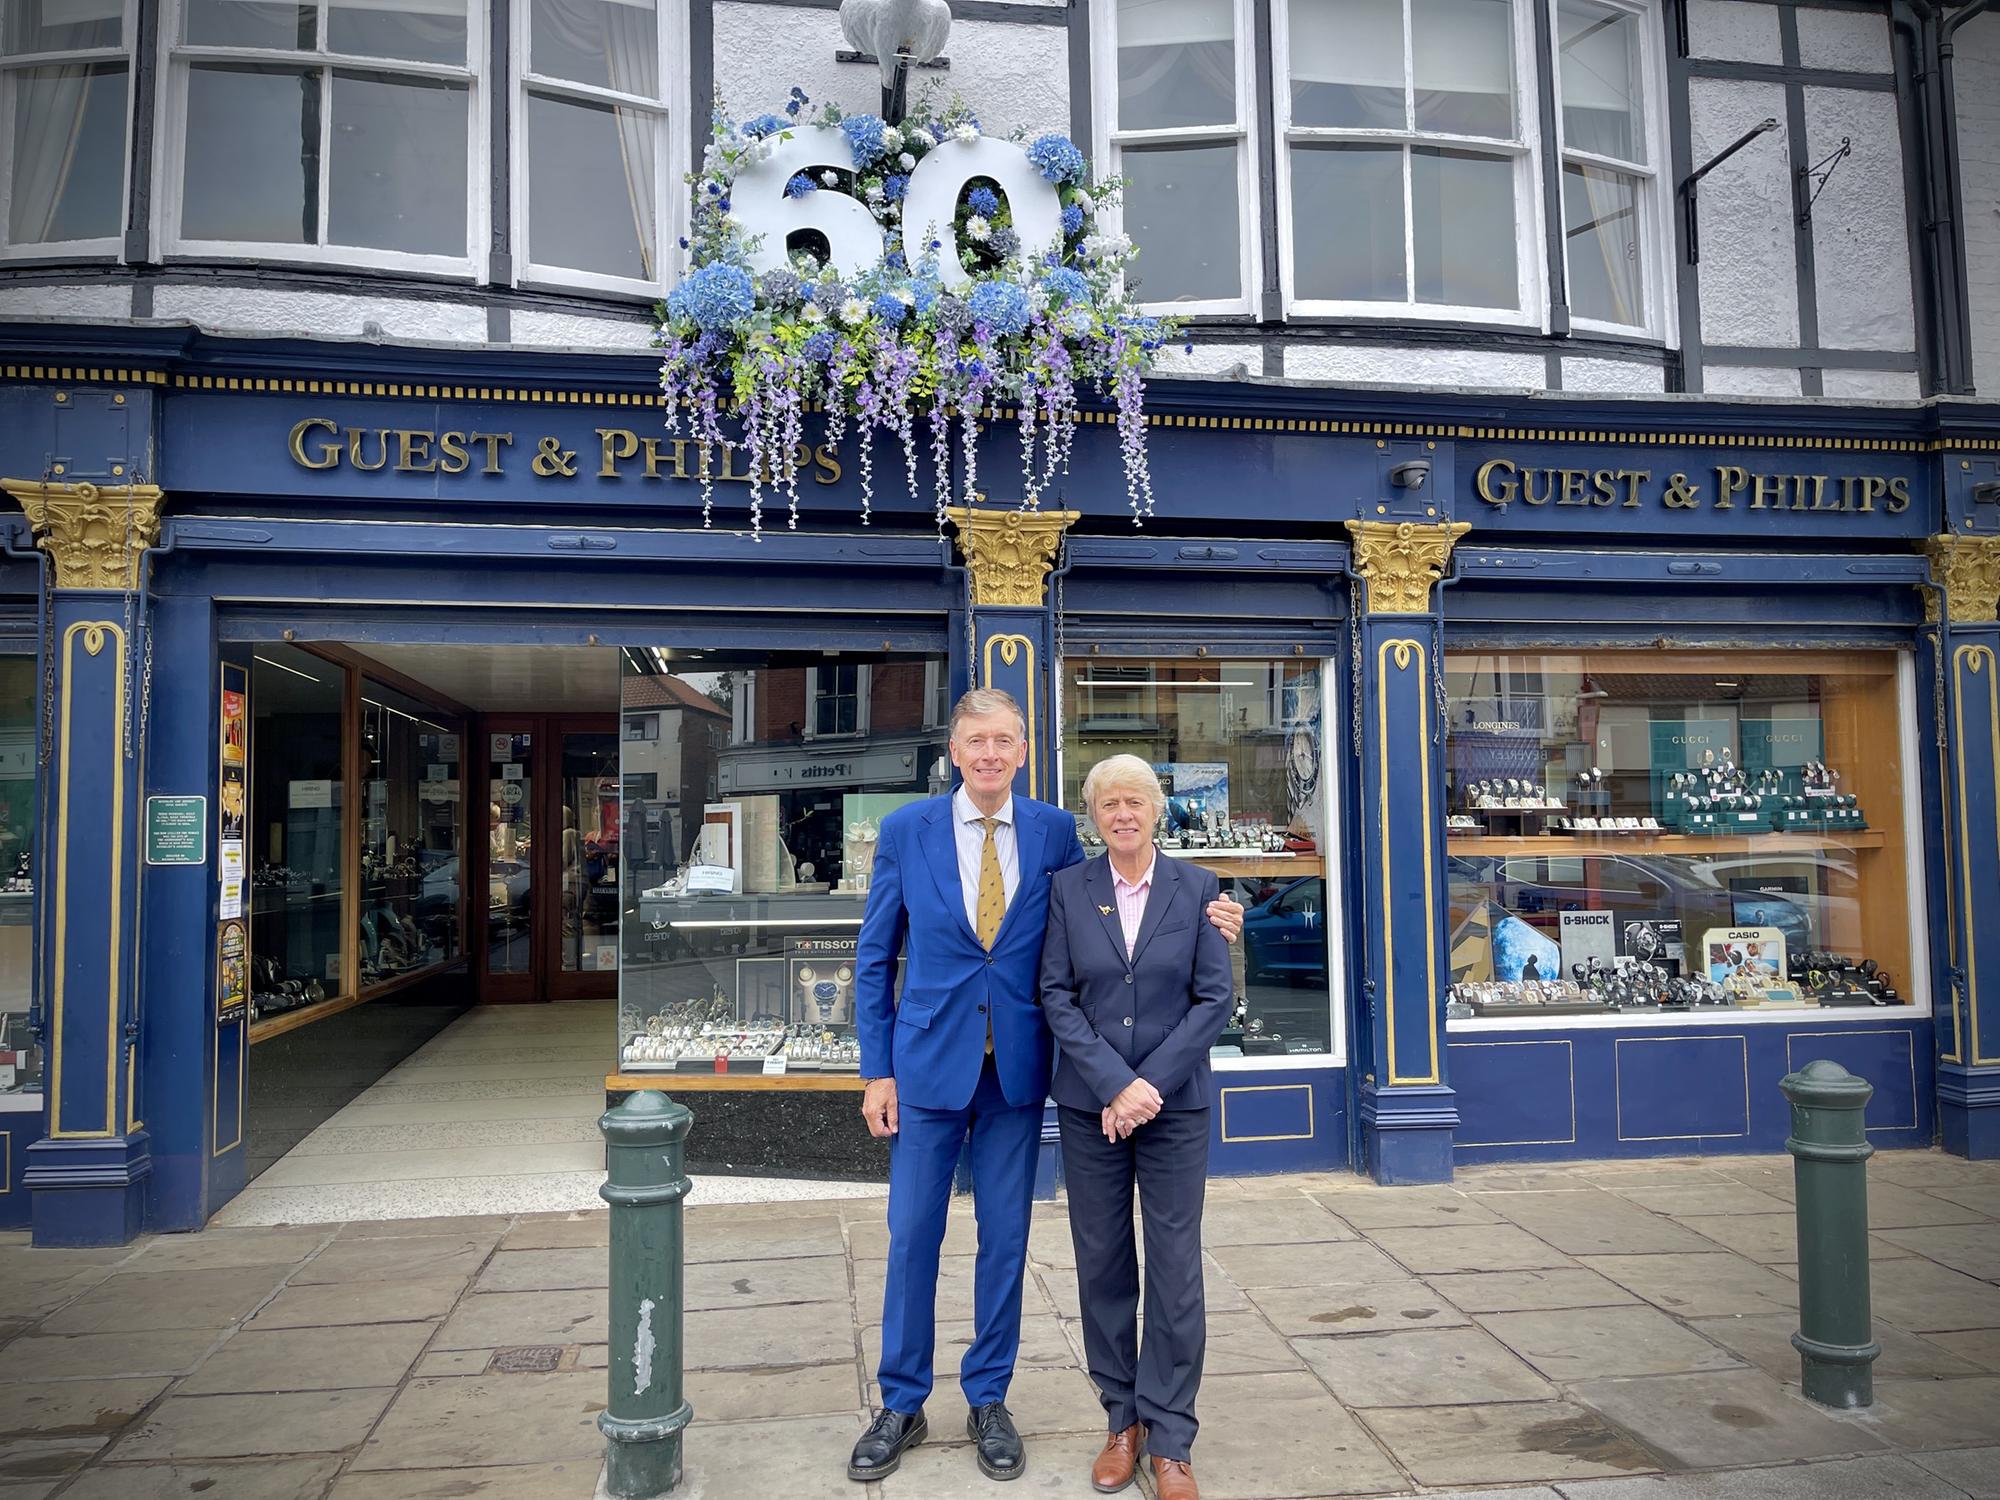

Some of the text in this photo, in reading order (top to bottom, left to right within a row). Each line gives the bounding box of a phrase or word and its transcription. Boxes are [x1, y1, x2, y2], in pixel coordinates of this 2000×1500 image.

[730, 125, 1063, 292] 60
[288, 417, 513, 474] GUEST
[532, 436, 578, 477] &
[1476, 459, 1911, 513] GUEST & PHILIPS
[1472, 721, 1520, 730] LONGINES
[1672, 735, 1710, 744] GUCCI
[1765, 734, 1803, 743] GUCCI
[1564, 915, 1610, 926] G-SHOCK
[1728, 931, 1760, 940] CASIO
[812, 940, 857, 950] TISSOT
